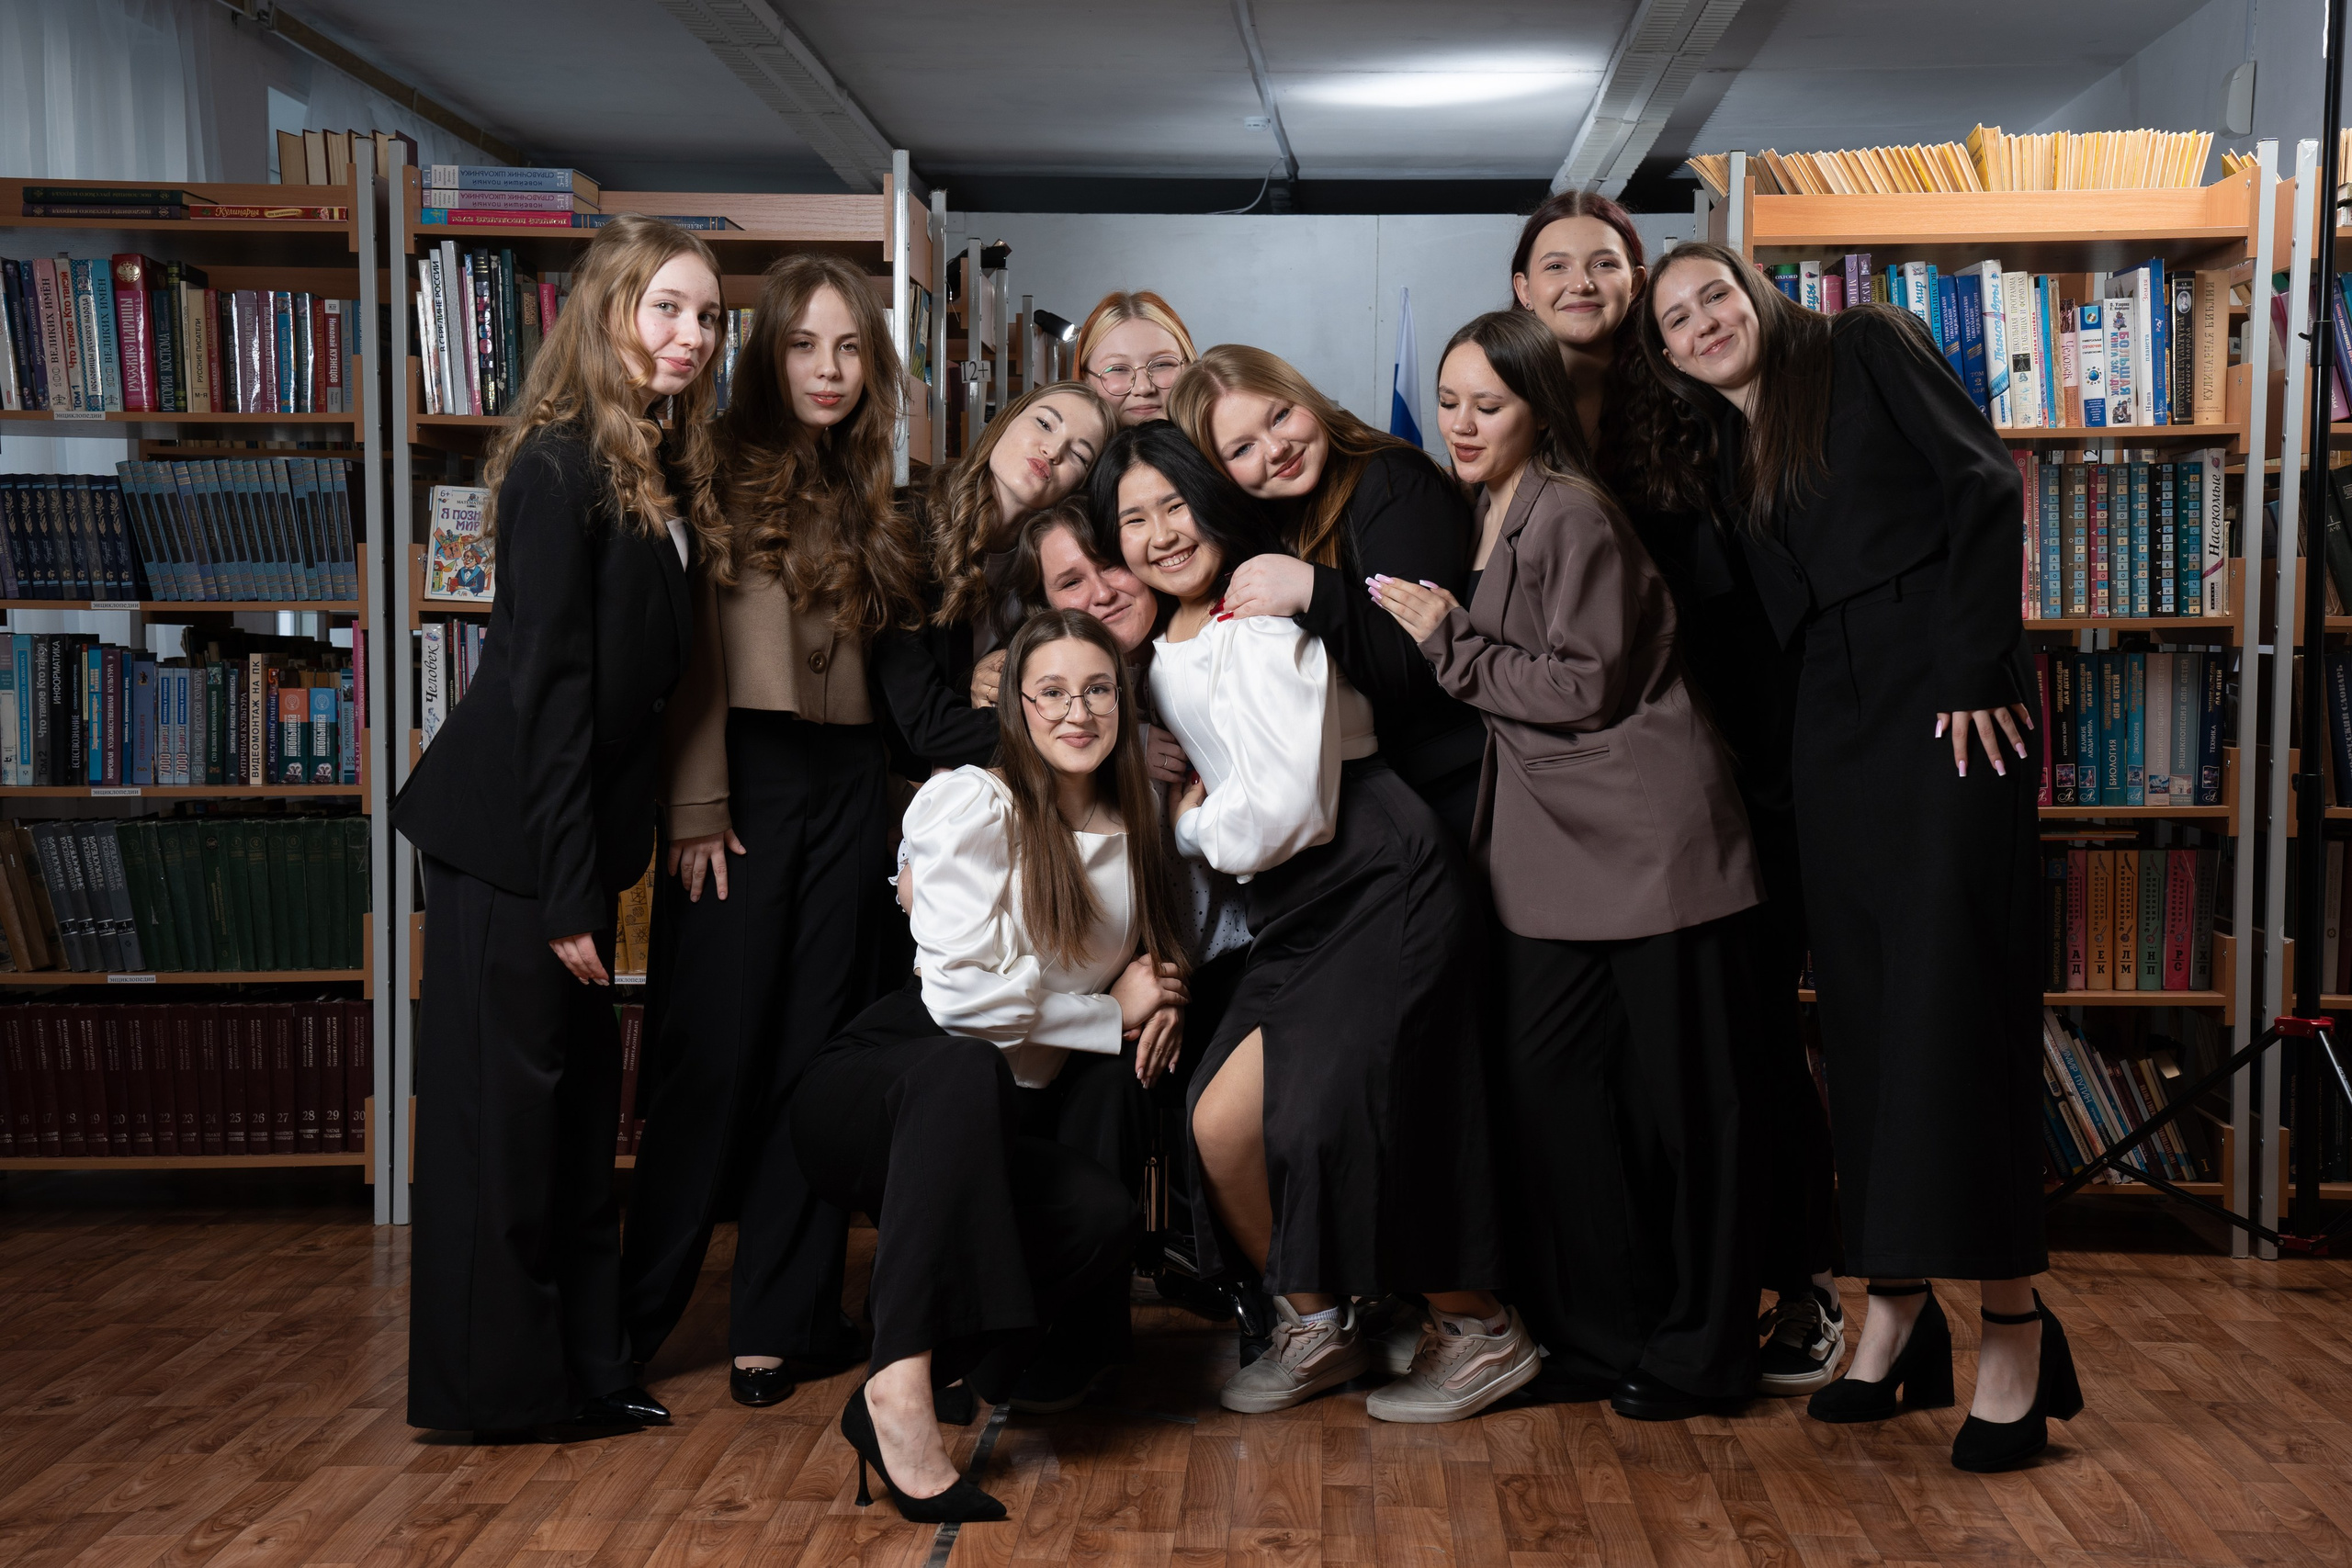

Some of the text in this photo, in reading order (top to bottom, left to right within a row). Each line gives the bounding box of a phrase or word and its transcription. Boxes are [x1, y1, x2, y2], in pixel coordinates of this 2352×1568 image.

[460, 170, 506, 178] ШКОЛЬНИКА
[215, 207, 259, 217] Кулинария
[460, 193, 506, 201] ШКОЛЬНИКА
[40, 277, 52, 309] ИМЁН
[63, 300, 72, 317] Кто
[433, 261, 447, 344] СЕРЕДИНЕ РОССИИ
[1915, 281, 1927, 306] мир
[1930, 272, 1940, 324] ВСЕМИРНАЯ
[96, 277, 113, 363] ВЕЛИКИХ ИМЁН
[120, 298, 136, 343] ЦАРИЦЫ
[1990, 283, 2006, 364] Динозавры
[2009, 276, 2019, 352] ШКОЛЬНАЯ ПРОГРАММА
[2018, 276, 2028, 346] ТАБЛИЦАХ ФОРМУЛАХ
[47, 313, 59, 363] ВЕЛИКИХ
[66, 321, 75, 348] такое
[329, 318, 338, 383] Николай КУЗНЕЦОВ
[2203, 281, 2214, 400] КУЛИНАРНАЯ БИБЛИЯ
[69, 350, 77, 367] Что
[124, 344, 141, 391] РУССКИЕ
[158, 333, 172, 371] КОСТЮМА
[2062, 341, 2074, 379] Человек
[2109, 333, 2120, 396] КНИГА ЗАГАДОК
[2120, 332, 2131, 396] БОЛЬШАЯ
[2176, 316, 2185, 414] ИСТОРИЯ КУЛЬТУРЫ
[962, 360, 989, 381] 12+
[1975, 378, 1982, 386] 2
[73, 392, 82, 409] Том
[161, 376, 175, 411] ИСТОРИЯ
[441, 508, 450, 519] Я
[456, 520, 481, 531] МИР
[2209, 474, 2222, 557] Насекомые
[37, 672, 46, 688] Кто
[52, 640, 61, 704] ИНФОРМАТИКА
[424, 643, 439, 703] Человек
[2336, 663, 2347, 707] СЛОВАРЬ
[38, 720, 47, 738] Что
[252, 660, 260, 777] ВИДЕОМОНТАЖ НА ПК
[71, 715, 80, 768] ЕСТЕСТВОЗНАНИЕ
[38, 759, 48, 776] Том
[160, 753, 171, 775] 7000
[176, 753, 187, 775] 7000
[47, 836, 65, 890] ЭНЦИКЛОПЕДИЯ
[60, 836, 78, 891] МАТЕМАТИЧЕСКАЯ
[67, 836, 85, 889] ЭНЦИКЛОПЕДИЯ
[88, 836, 105, 890] ЭНЦИКЛОПЕДИЯ
[101, 836, 117, 891] МАТЕМАТИЧЕСКАЯ
[107, 835, 124, 889] ЭНЦИКЛОПЕДИЯ
[62, 1019, 72, 1070] ЭНЦИКЛОПЕДИЯ
[86, 1019, 96, 1070] ЭНЦИКЛОПЕДИЯ
[2075, 1075, 2093, 1104] ПУТИН
[19, 1114, 29, 1124] 16
[66, 1113, 76, 1123] 18
[113, 1113, 125, 1124] 20
[137, 1113, 147, 1123] 21
[159, 1112, 170, 1122] 22
[182, 1113, 194, 1123] 23
[206, 1113, 216, 1123] 24
[230, 1112, 241, 1122] 25
[253, 1112, 265, 1122] 26
[277, 1112, 288, 1122] 27
[302, 1111, 315, 1121] 28
[326, 1110, 339, 1121] 29
[353, 1111, 365, 1121] 30
